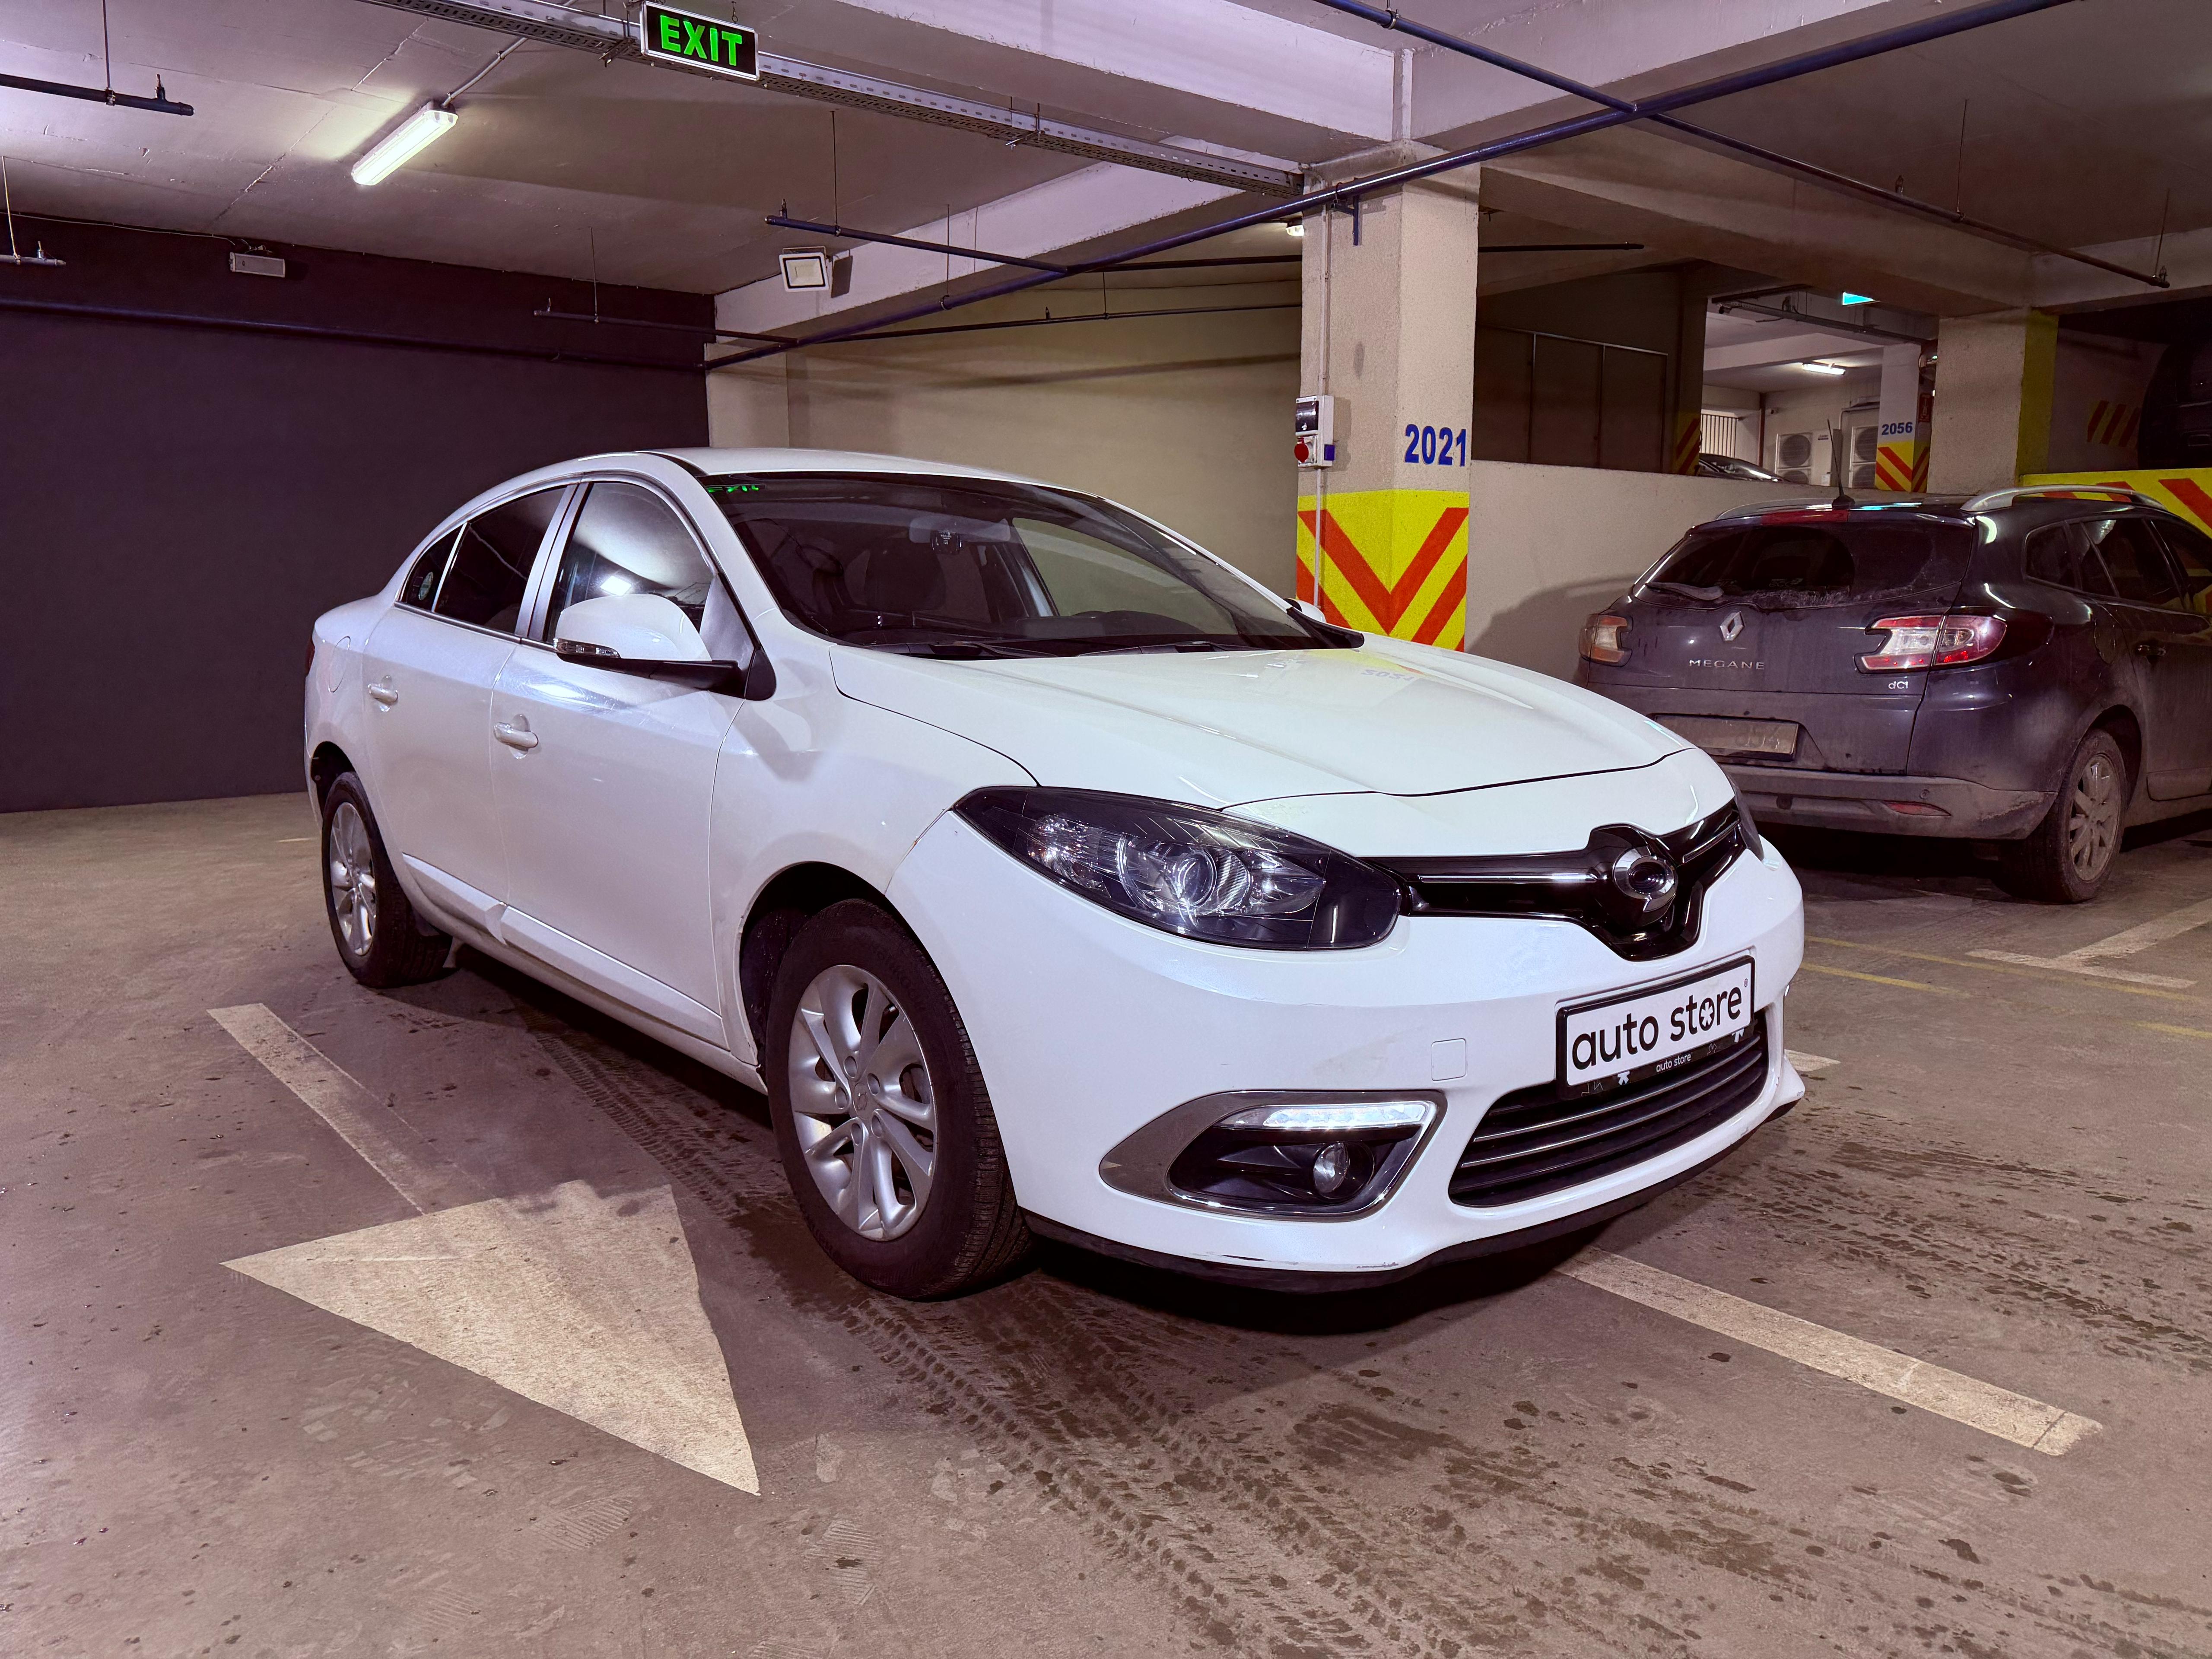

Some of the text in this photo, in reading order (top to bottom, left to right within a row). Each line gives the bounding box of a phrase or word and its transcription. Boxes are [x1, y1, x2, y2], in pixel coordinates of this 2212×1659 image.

[660, 15, 742, 66] EXIT
[1881, 422, 1913, 435] 2056
[1404, 424, 1466, 467] 2021
[1689, 660, 1765, 670] MEGANE
[1572, 1013, 1659, 1070] auto
[1656, 1054, 1691, 1072] auto store
